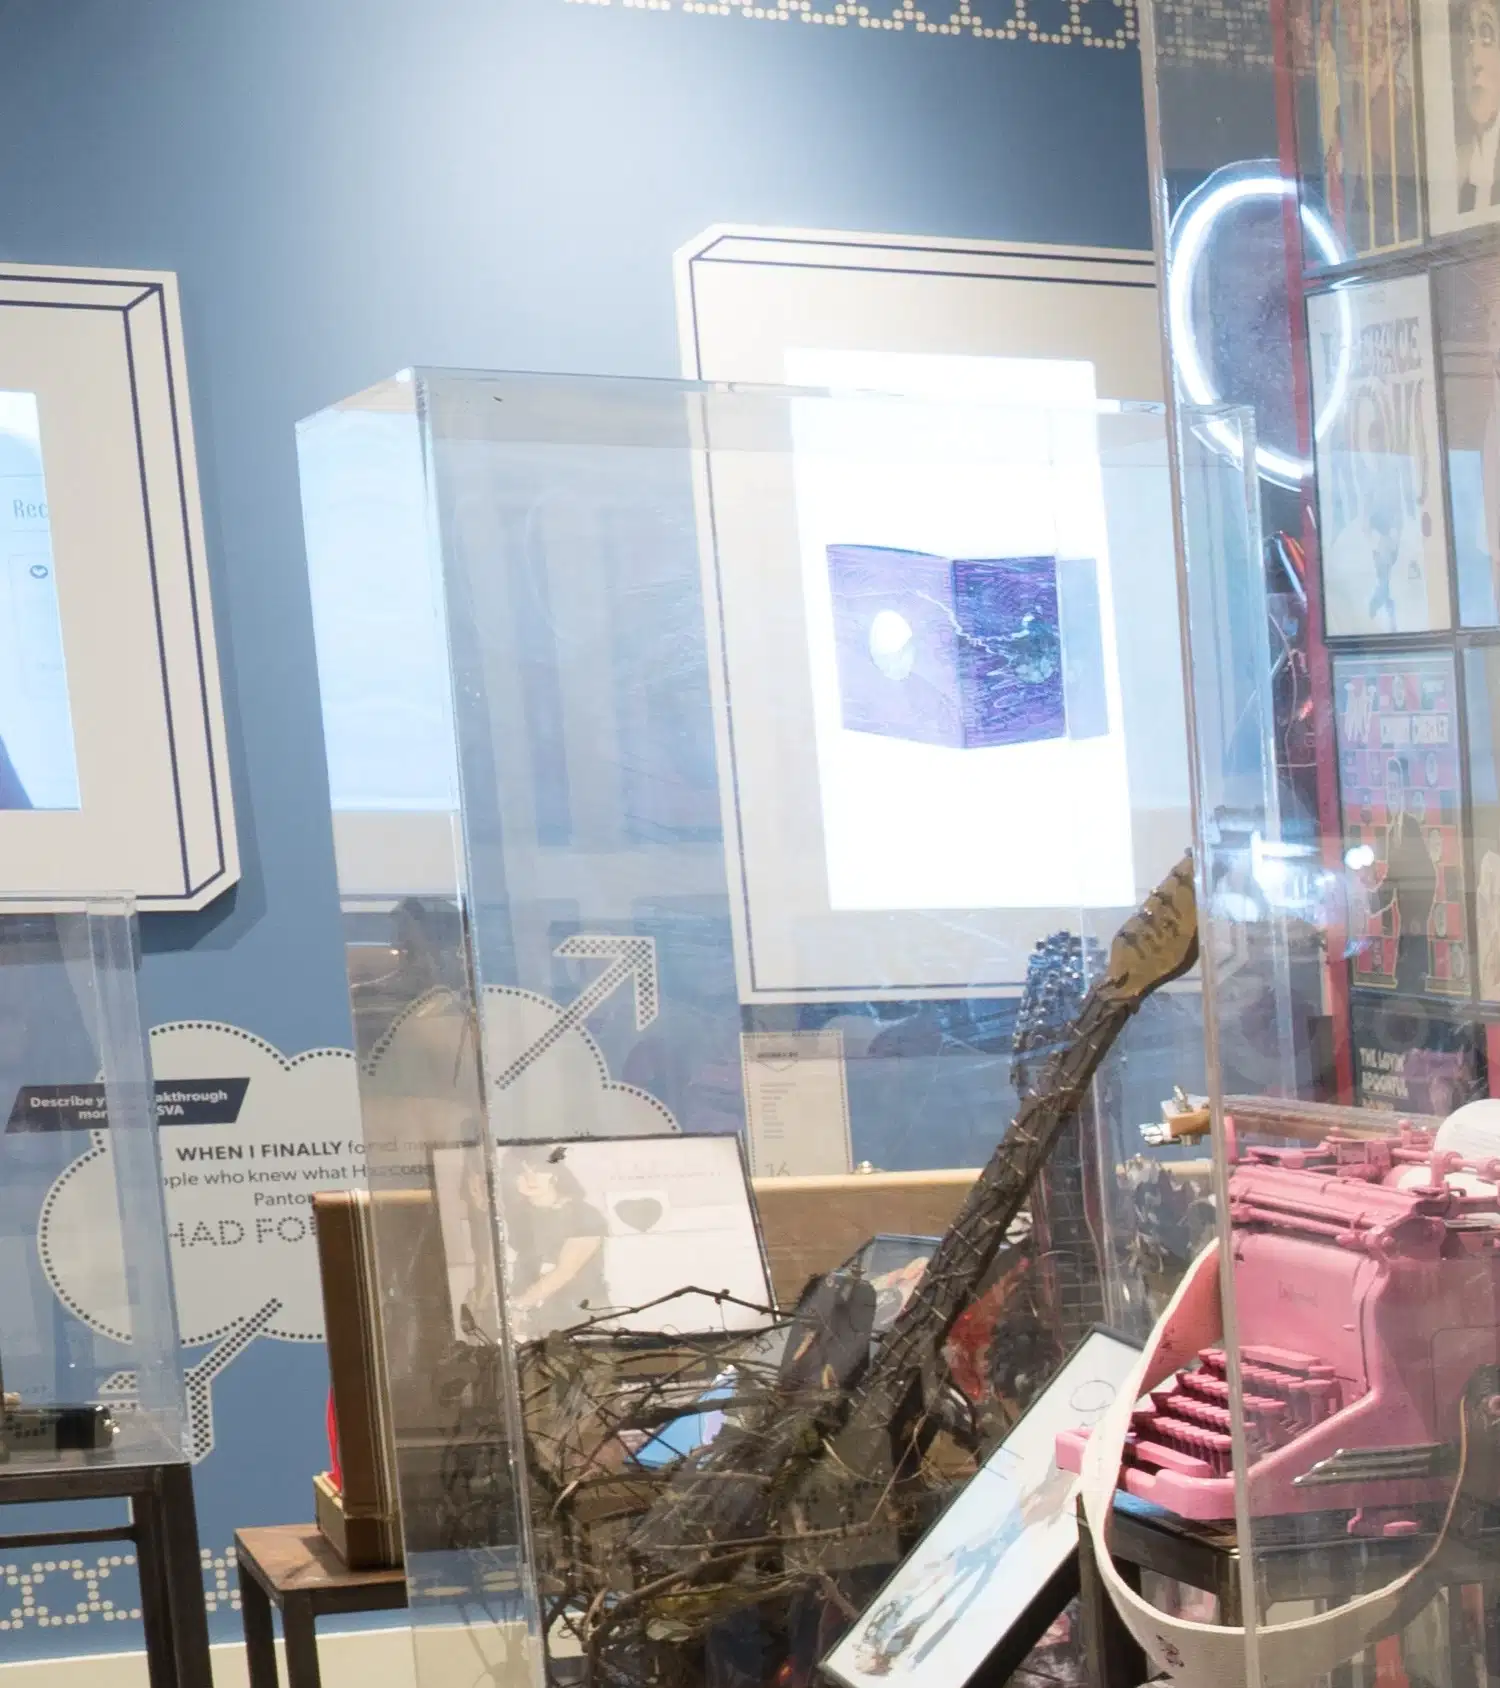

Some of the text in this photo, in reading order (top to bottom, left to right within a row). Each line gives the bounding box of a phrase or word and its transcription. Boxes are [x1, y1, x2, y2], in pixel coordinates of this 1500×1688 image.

[30, 1094, 94, 1109] Describe
[157, 1104, 185, 1117] SVA
[176, 1141, 344, 1162] WHEN I FINALLY
[164, 1173, 199, 1188] ople
[204, 1169, 244, 1185] who
[249, 1167, 297, 1183] knew
[302, 1164, 349, 1181] what
